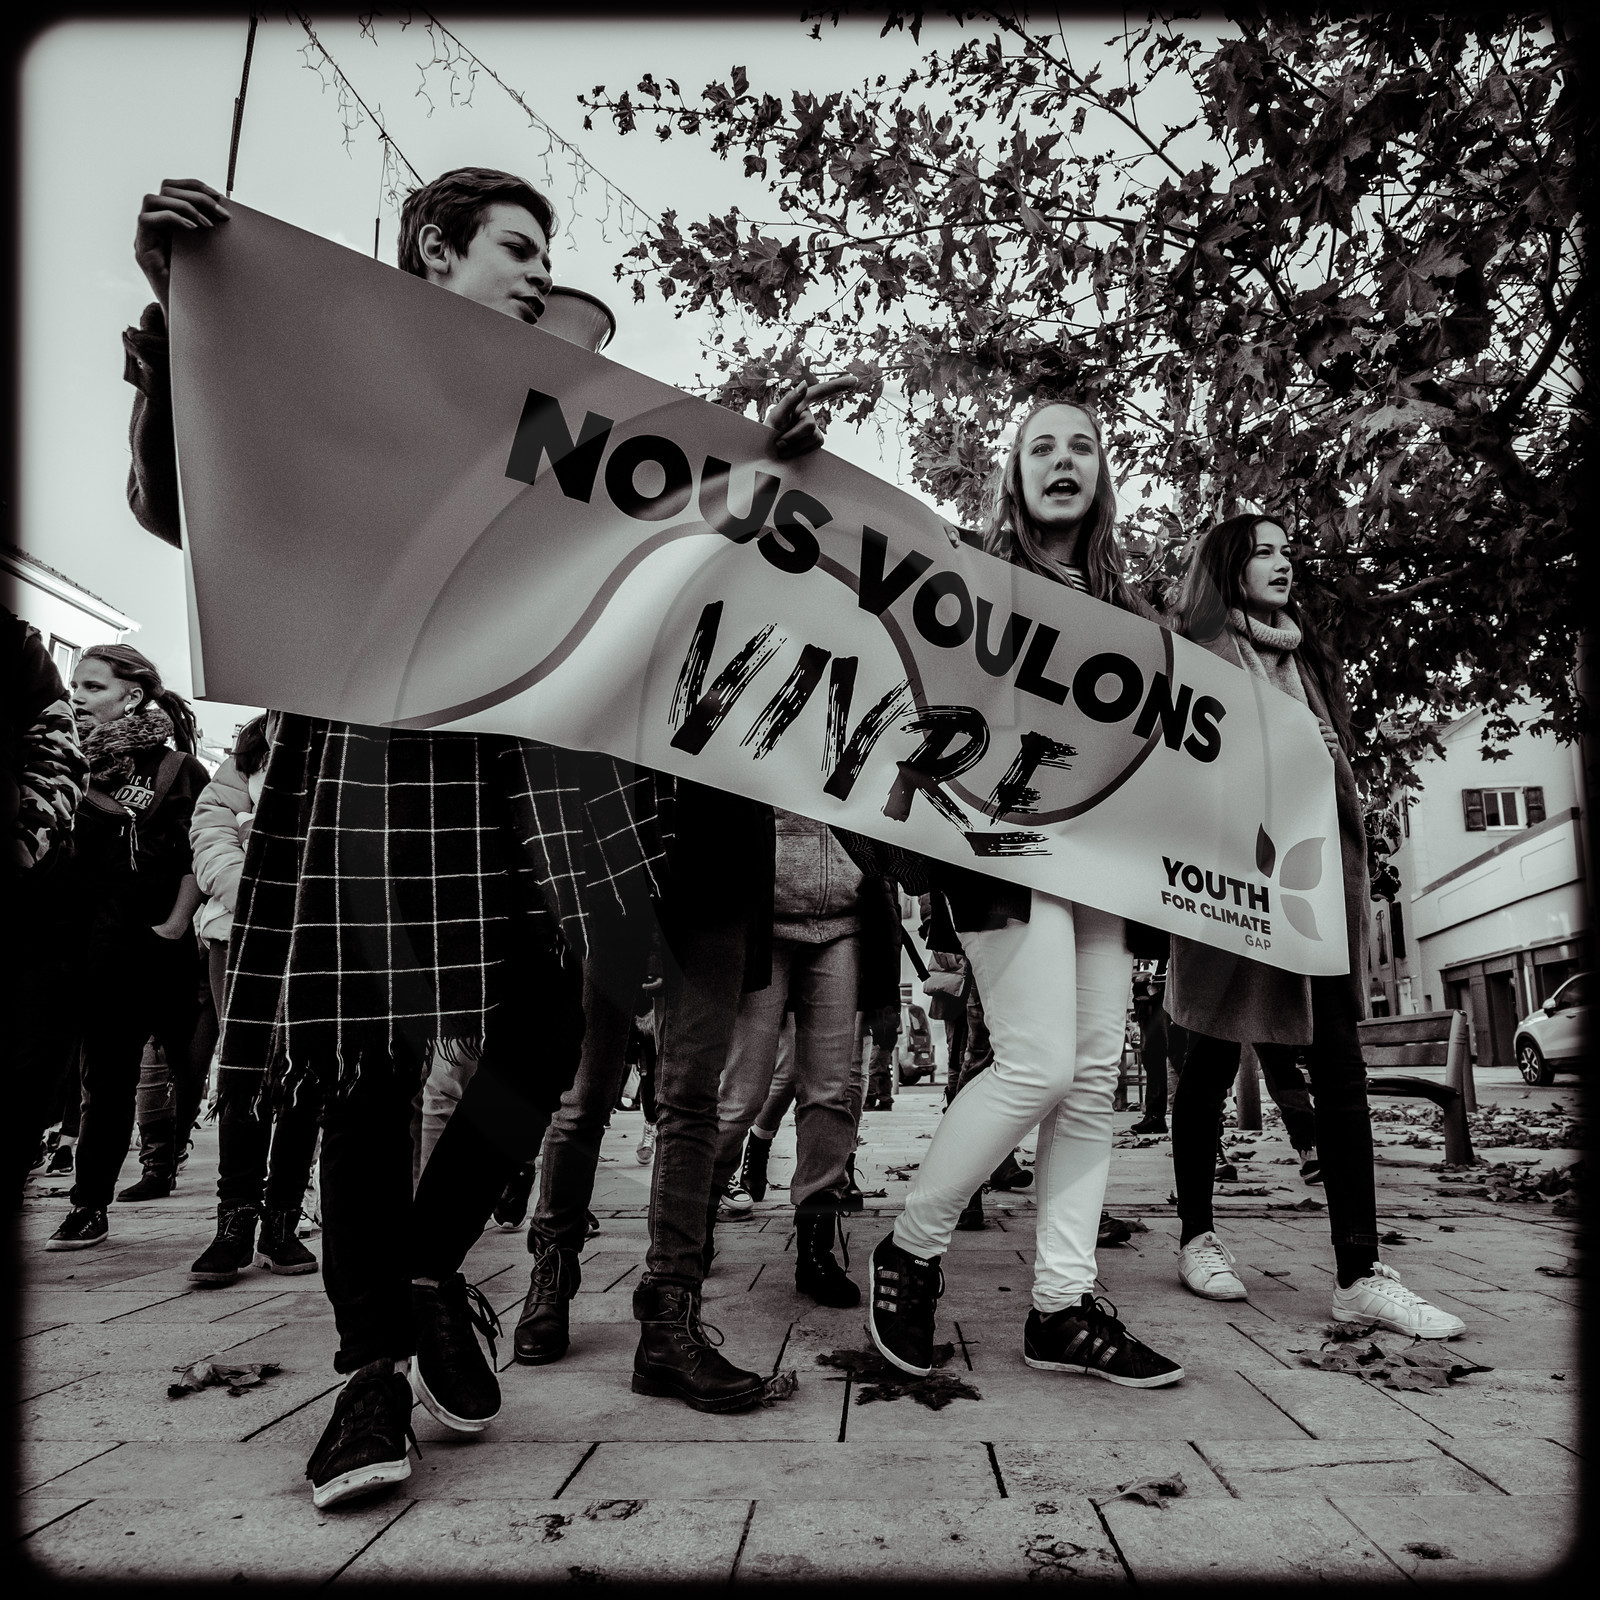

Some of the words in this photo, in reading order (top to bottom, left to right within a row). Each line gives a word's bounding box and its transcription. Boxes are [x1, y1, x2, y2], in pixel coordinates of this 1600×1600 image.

[505, 388, 834, 575] NOUS
[857, 526, 1227, 764] VOULONS
[669, 600, 1078, 857] VIVRE
[1161, 856, 1270, 913] YOUTH
[1161, 891, 1197, 914] FOR
[1200, 902, 1271, 935] CLIMATE
[1244, 934, 1272, 951] GAP
